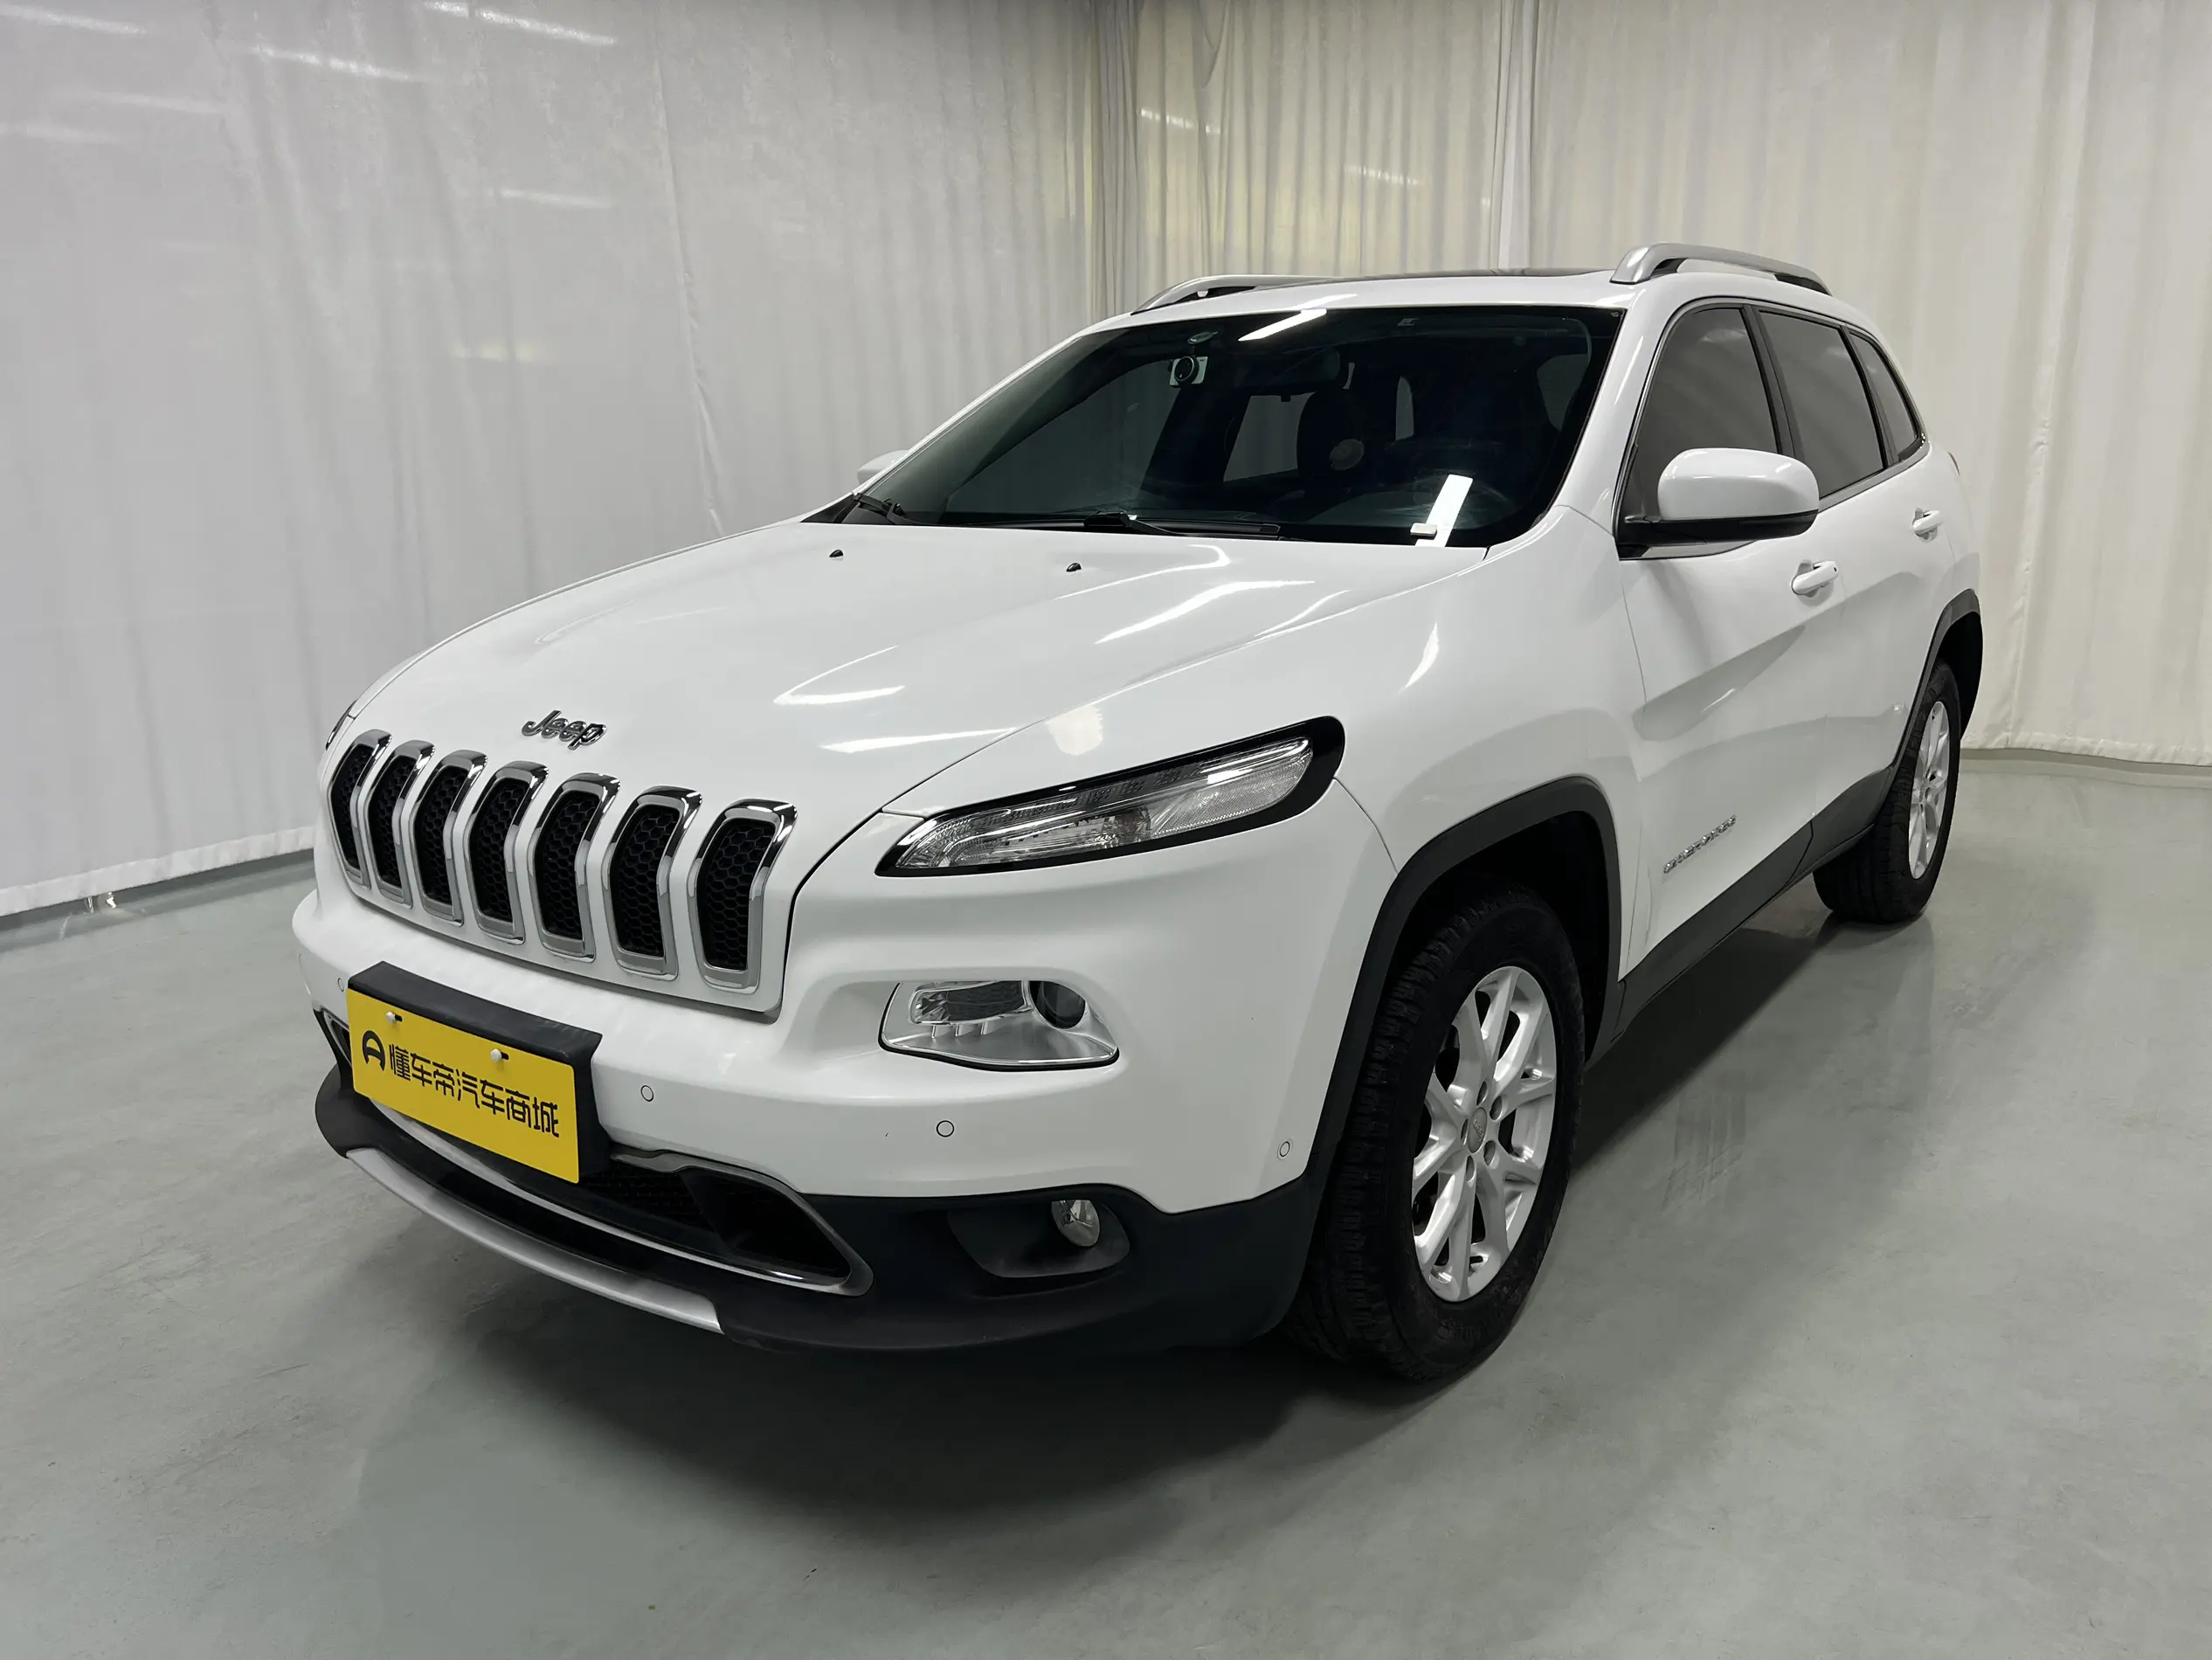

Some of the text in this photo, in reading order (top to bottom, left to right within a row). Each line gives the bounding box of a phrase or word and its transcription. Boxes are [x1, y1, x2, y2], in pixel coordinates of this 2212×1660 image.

[522, 709, 607, 750] Jeep
[389, 1043, 560, 1138] 懂车帝汽车商城
